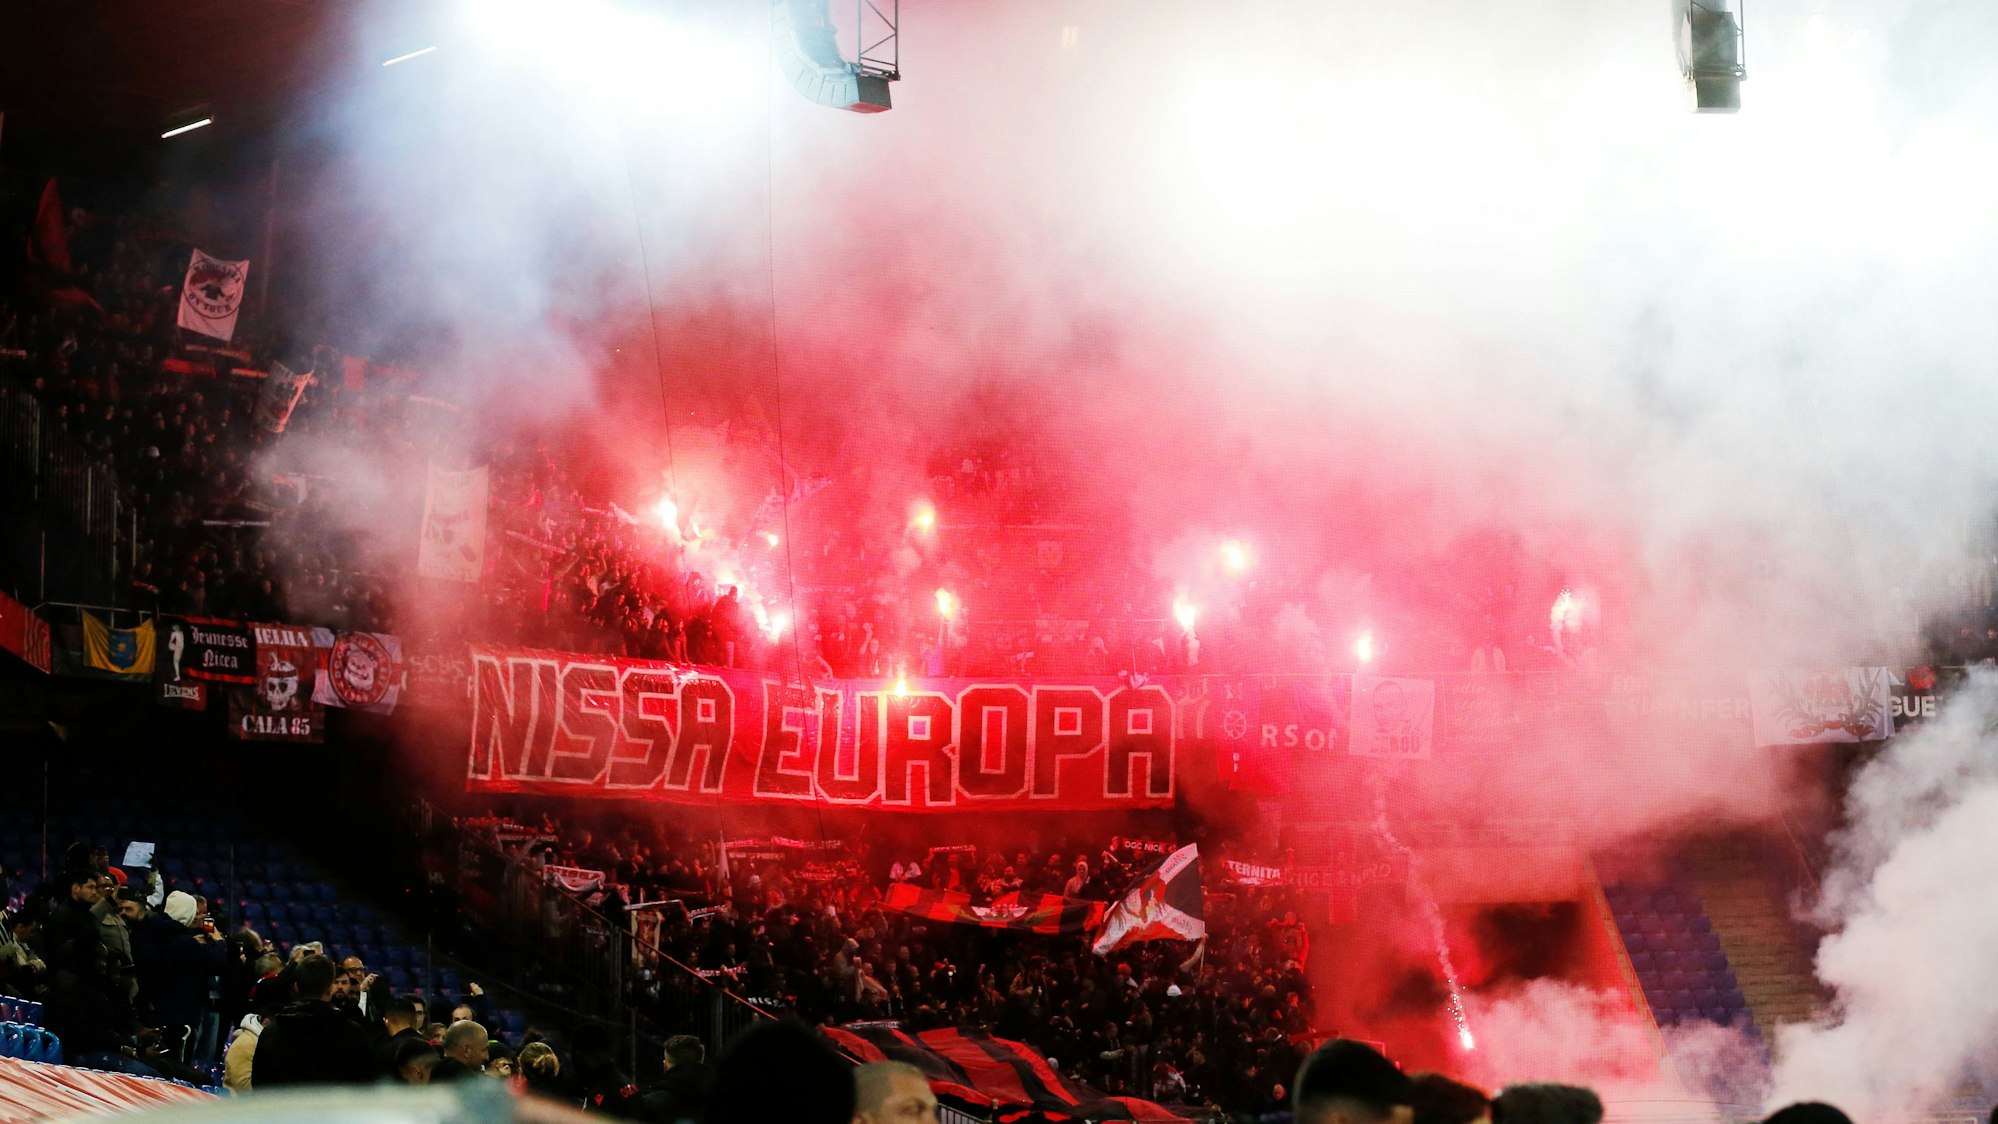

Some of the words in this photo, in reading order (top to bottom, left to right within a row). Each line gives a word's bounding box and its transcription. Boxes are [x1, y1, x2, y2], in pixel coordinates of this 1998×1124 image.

[189, 625, 249, 649] Jeunesse
[163, 683, 200, 701] LEVENS
[241, 714, 288, 735] CALA
[290, 718, 311, 735] 85
[468, 655, 735, 794] NISSA
[754, 680, 1177, 808] EUROPA
[1124, 840, 1143, 850] OGC
[1144, 843, 1163, 852] NICE
